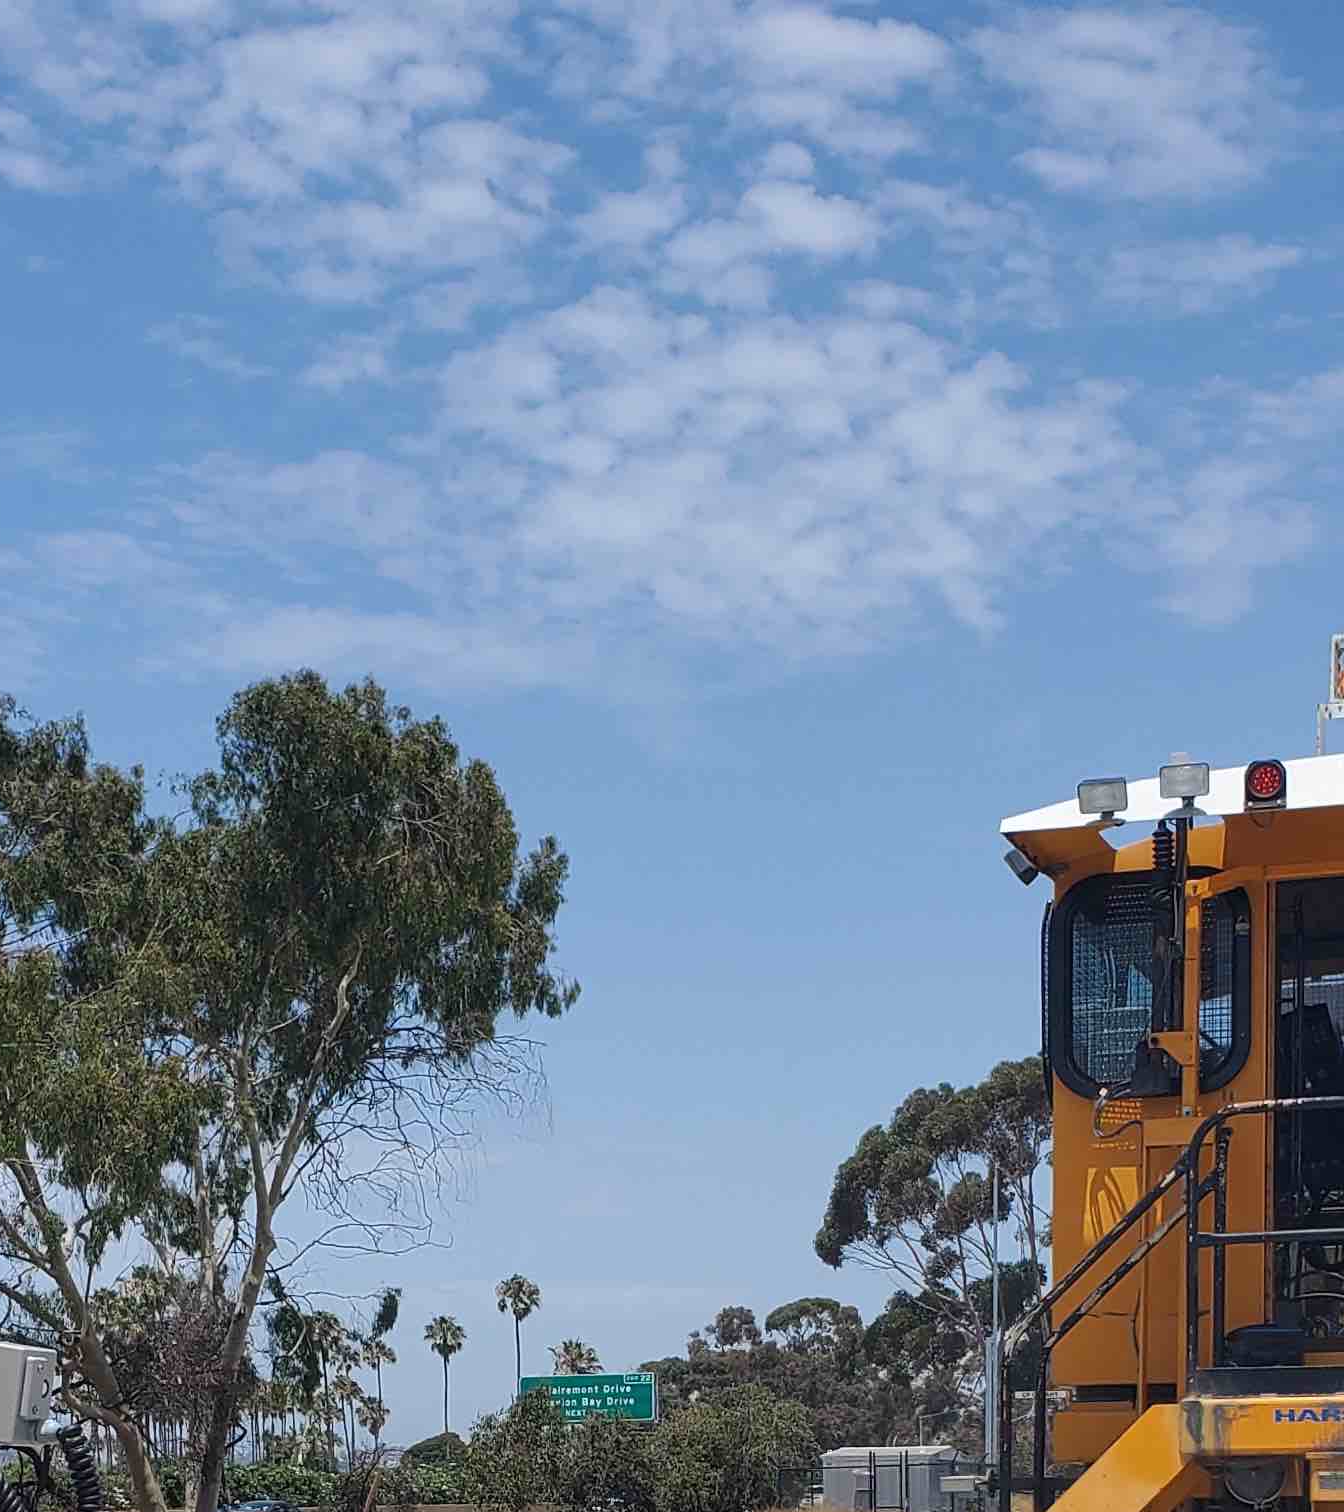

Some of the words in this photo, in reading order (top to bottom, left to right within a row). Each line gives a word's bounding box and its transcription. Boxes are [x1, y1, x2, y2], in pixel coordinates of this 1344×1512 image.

[640, 1374, 651, 1382] 22
[548, 1385, 598, 1395] lairemont
[603, 1384, 632, 1393] Drive
[582, 1397, 602, 1408] Bay
[607, 1396, 635, 1406] Drive
